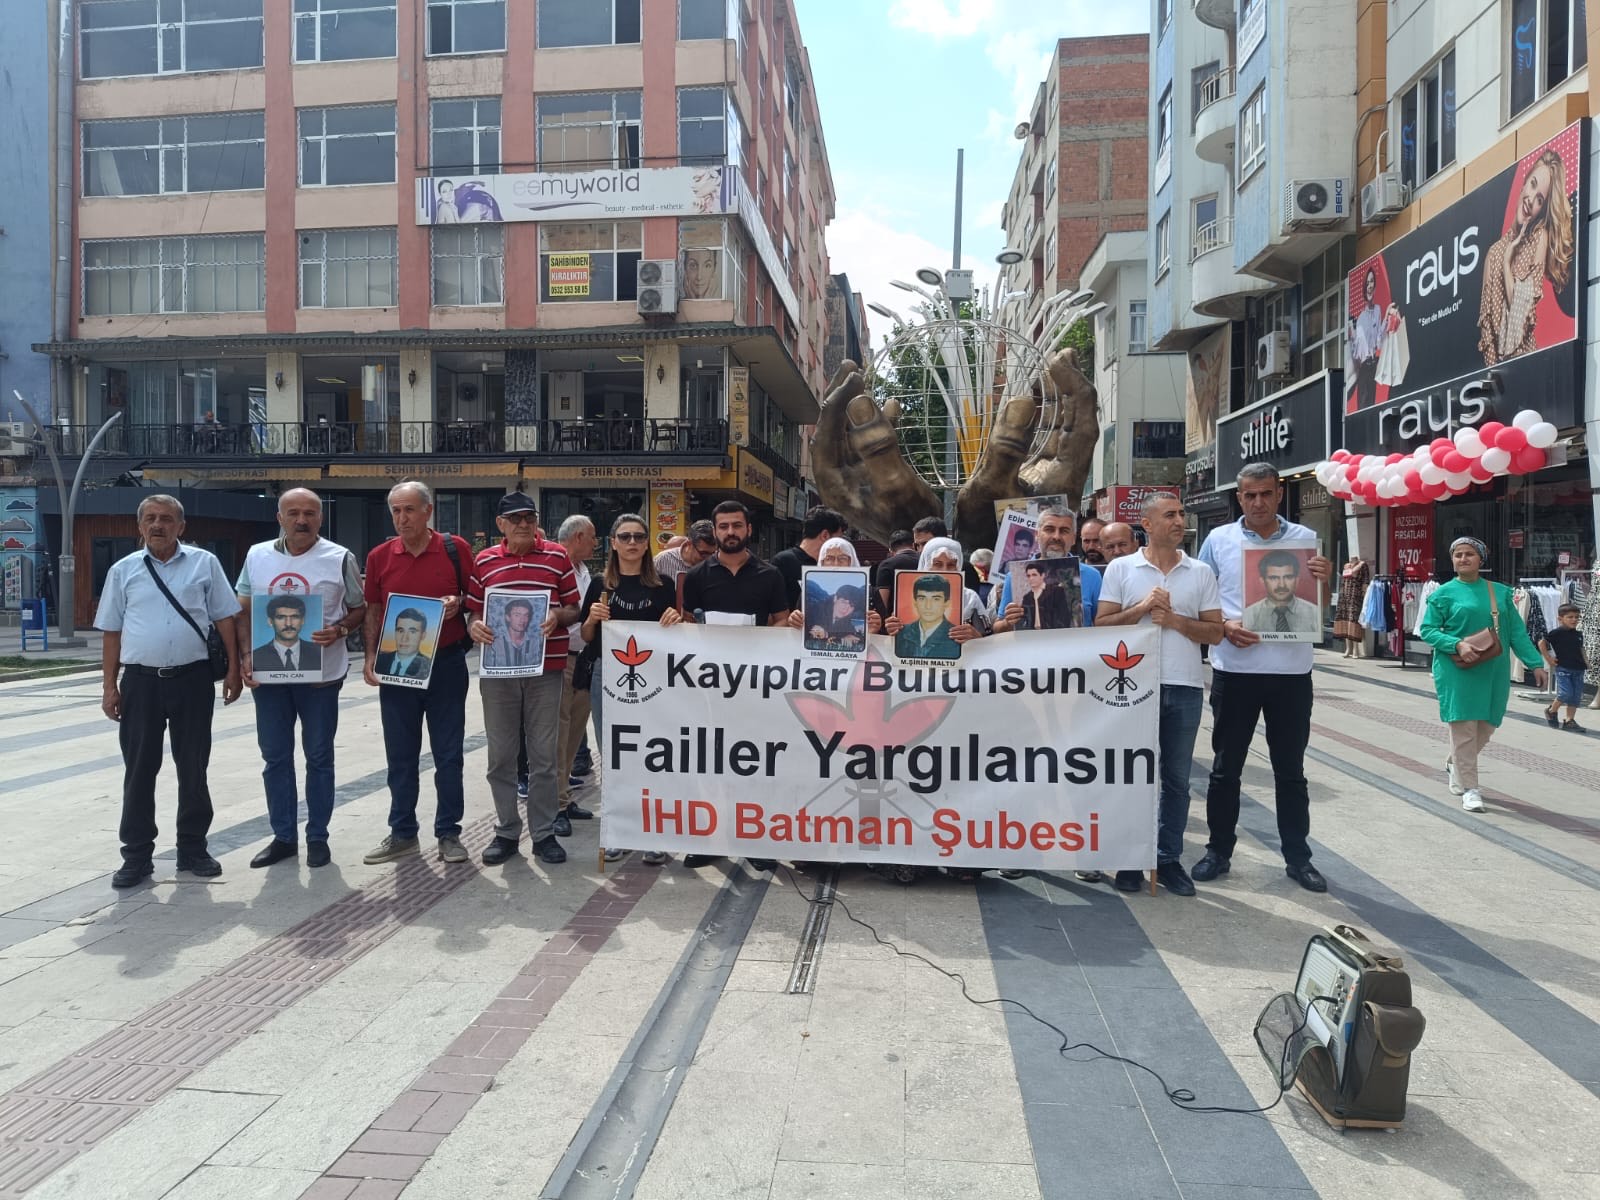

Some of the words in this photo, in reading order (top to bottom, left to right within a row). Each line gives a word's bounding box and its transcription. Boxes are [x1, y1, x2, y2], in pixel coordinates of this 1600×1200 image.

[513, 172, 640, 199] esmyworld
[1406, 226, 1480, 304] rays
[1240, 405, 1291, 459] stilife
[1379, 380, 1486, 445] rays
[581, 467, 613, 478] ŞEHİR
[615, 467, 662, 476] SOFRASI
[1008, 514, 1025, 524] EDİP
[1026, 519, 1038, 528] ÇE
[667, 653, 849, 698] Kayıplar
[863, 661, 1086, 695] Bulunsun
[611, 724, 788, 777] Failler
[804, 730, 1155, 794] Yargılansın
[641, 788, 718, 837] İHD
[735, 802, 913, 845] Batman
[931, 808, 1099, 857] Şubesi
